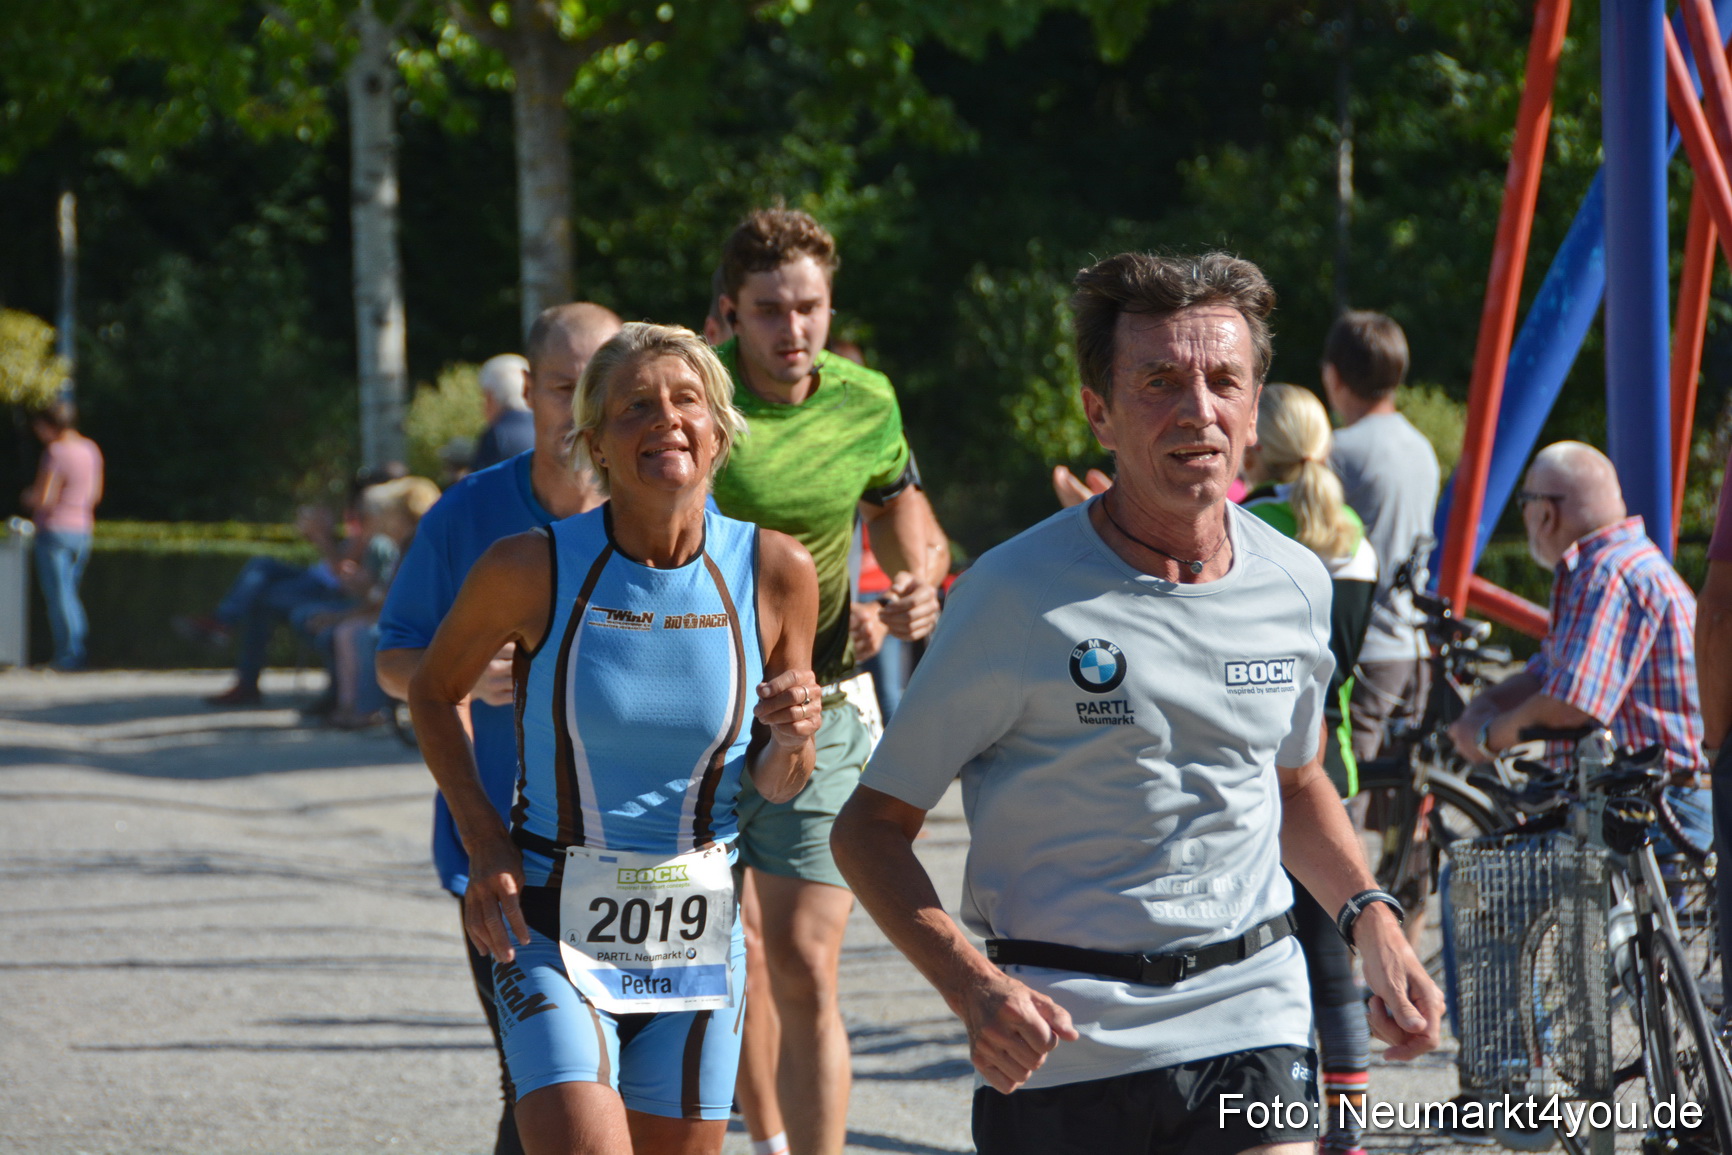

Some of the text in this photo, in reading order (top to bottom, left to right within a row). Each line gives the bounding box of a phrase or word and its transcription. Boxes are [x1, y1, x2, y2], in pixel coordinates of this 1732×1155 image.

[699, 613, 728, 628] RACER
[1072, 639, 1121, 660] BMW
[1225, 659, 1295, 686] BOCK
[1076, 699, 1135, 715] PARTL
[1079, 714, 1135, 725] Neumarkt
[617, 864, 689, 884] BOCK
[586, 894, 708, 945] 2019
[569, 933, 577, 942] A
[597, 950, 682, 962] PARTL Neumarkt
[621, 974, 672, 994] Petra
